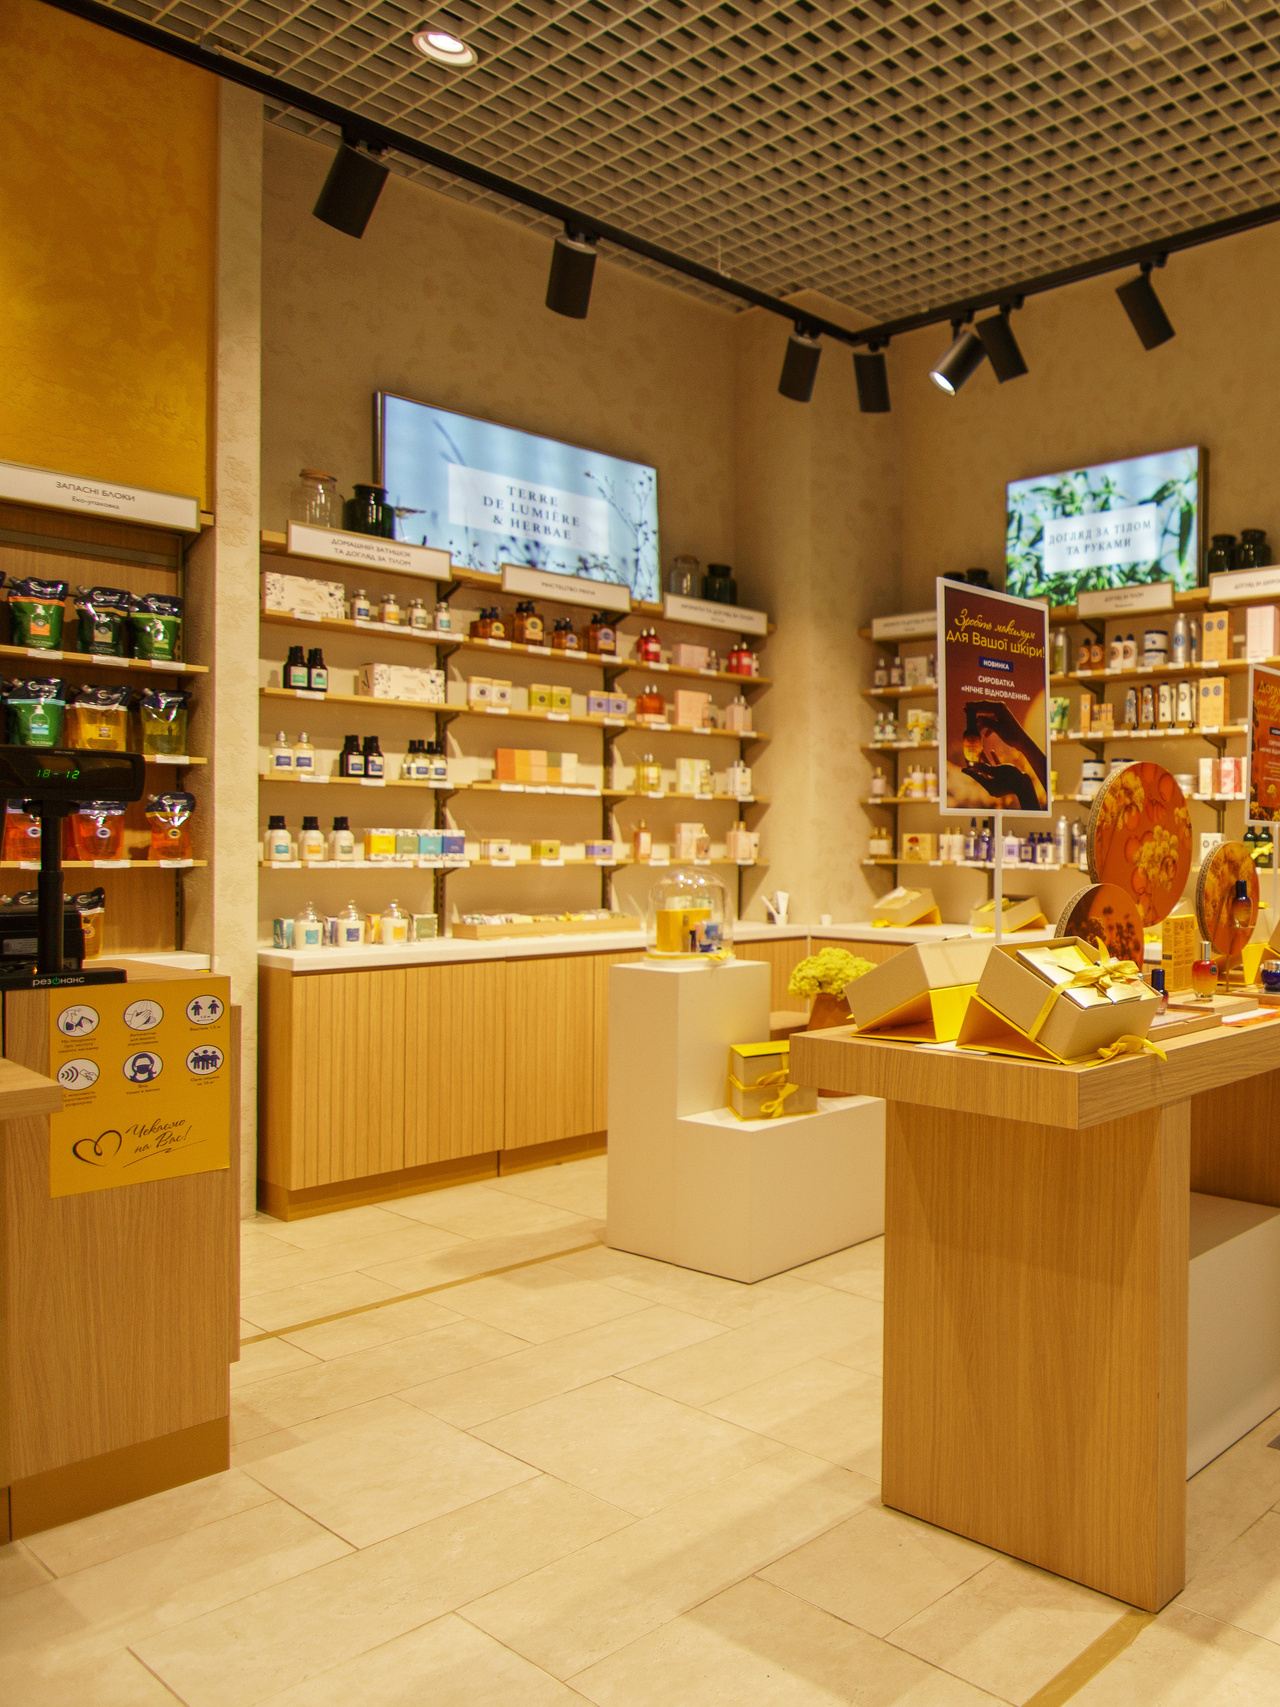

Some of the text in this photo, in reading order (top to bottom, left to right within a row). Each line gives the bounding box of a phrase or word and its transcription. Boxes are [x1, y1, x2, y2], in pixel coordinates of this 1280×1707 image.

[56, 481, 136, 501] ЗАПАСНІ БЛОКИ
[507, 486, 558, 506] TERRE
[483, 496, 580, 527] DE LUMIÈRE
[493, 515, 571, 540] & HERBAE
[1049, 529, 1092, 545] ДОГЛЯД
[1114, 520, 1151, 534] ТІЛОМ
[1084, 538, 1131, 553] РУКАМИ
[955, 608, 992, 631] Зробіть
[994, 620, 1036, 646] максимум
[972, 632, 1008, 651] Вашої
[1010, 642, 1045, 658] шкіри!
[983, 660, 1010, 670] НОВИНКА
[978, 675, 1015, 688] СИРОВАТКА
[961, 685, 1031, 701] «НІЧНЕ ВІДНОВЛЕННЯ»
[32, 976, 85, 987] резонанс
[134, 1125, 192, 1154] на Вас!
